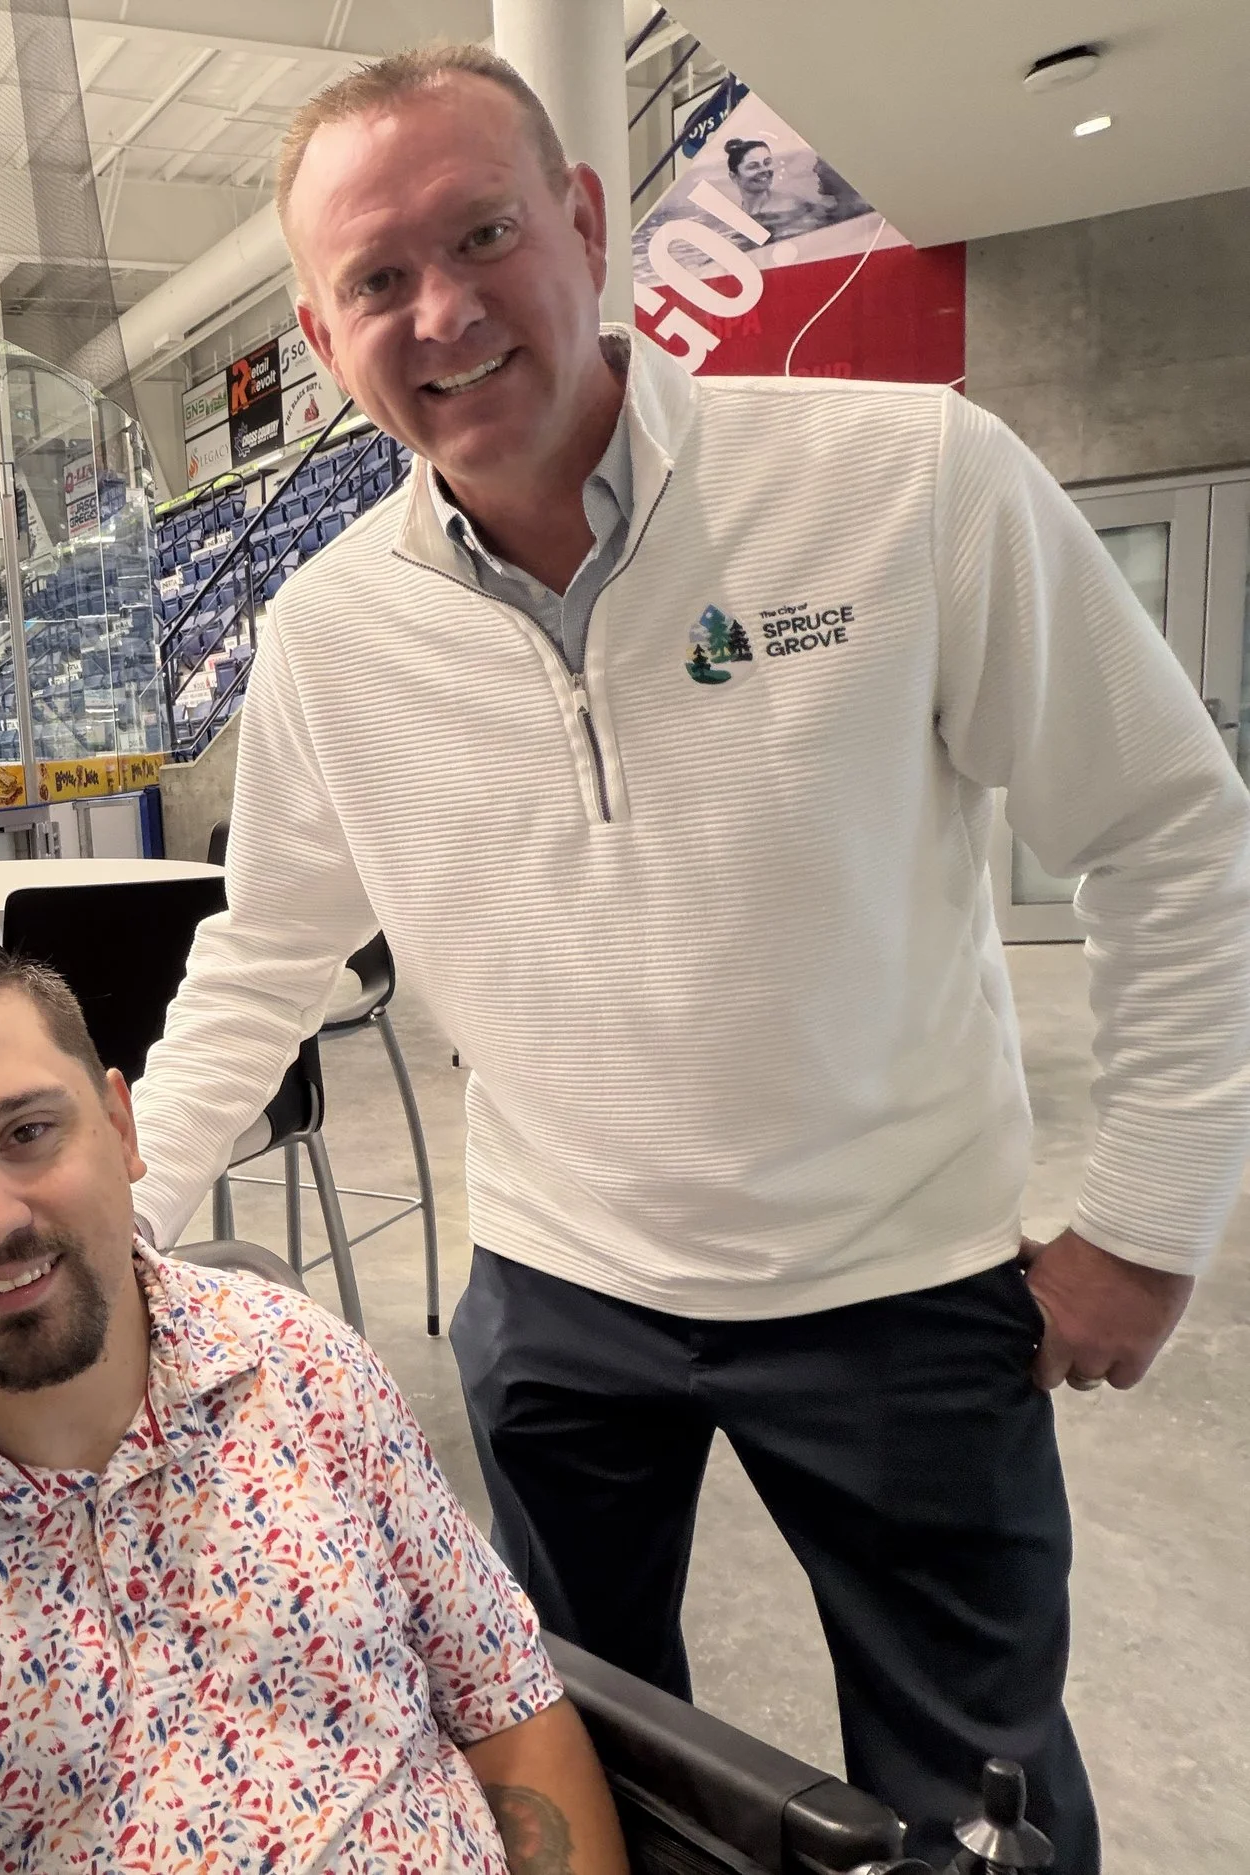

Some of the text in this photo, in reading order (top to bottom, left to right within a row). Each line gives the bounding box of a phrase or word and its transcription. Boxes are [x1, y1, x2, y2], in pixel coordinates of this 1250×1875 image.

[634, 180, 798, 376] GO!
[251, 369, 277, 395] Revolt
[185, 398, 205, 421] GNS
[200, 442, 229, 468] LEGACY
[75, 494, 97, 515] JASO
[69, 508, 97, 529] GREGO
[759, 602, 808, 620] The City of
[762, 605, 855, 639] SPRUCE
[765, 626, 849, 658] GROVE
